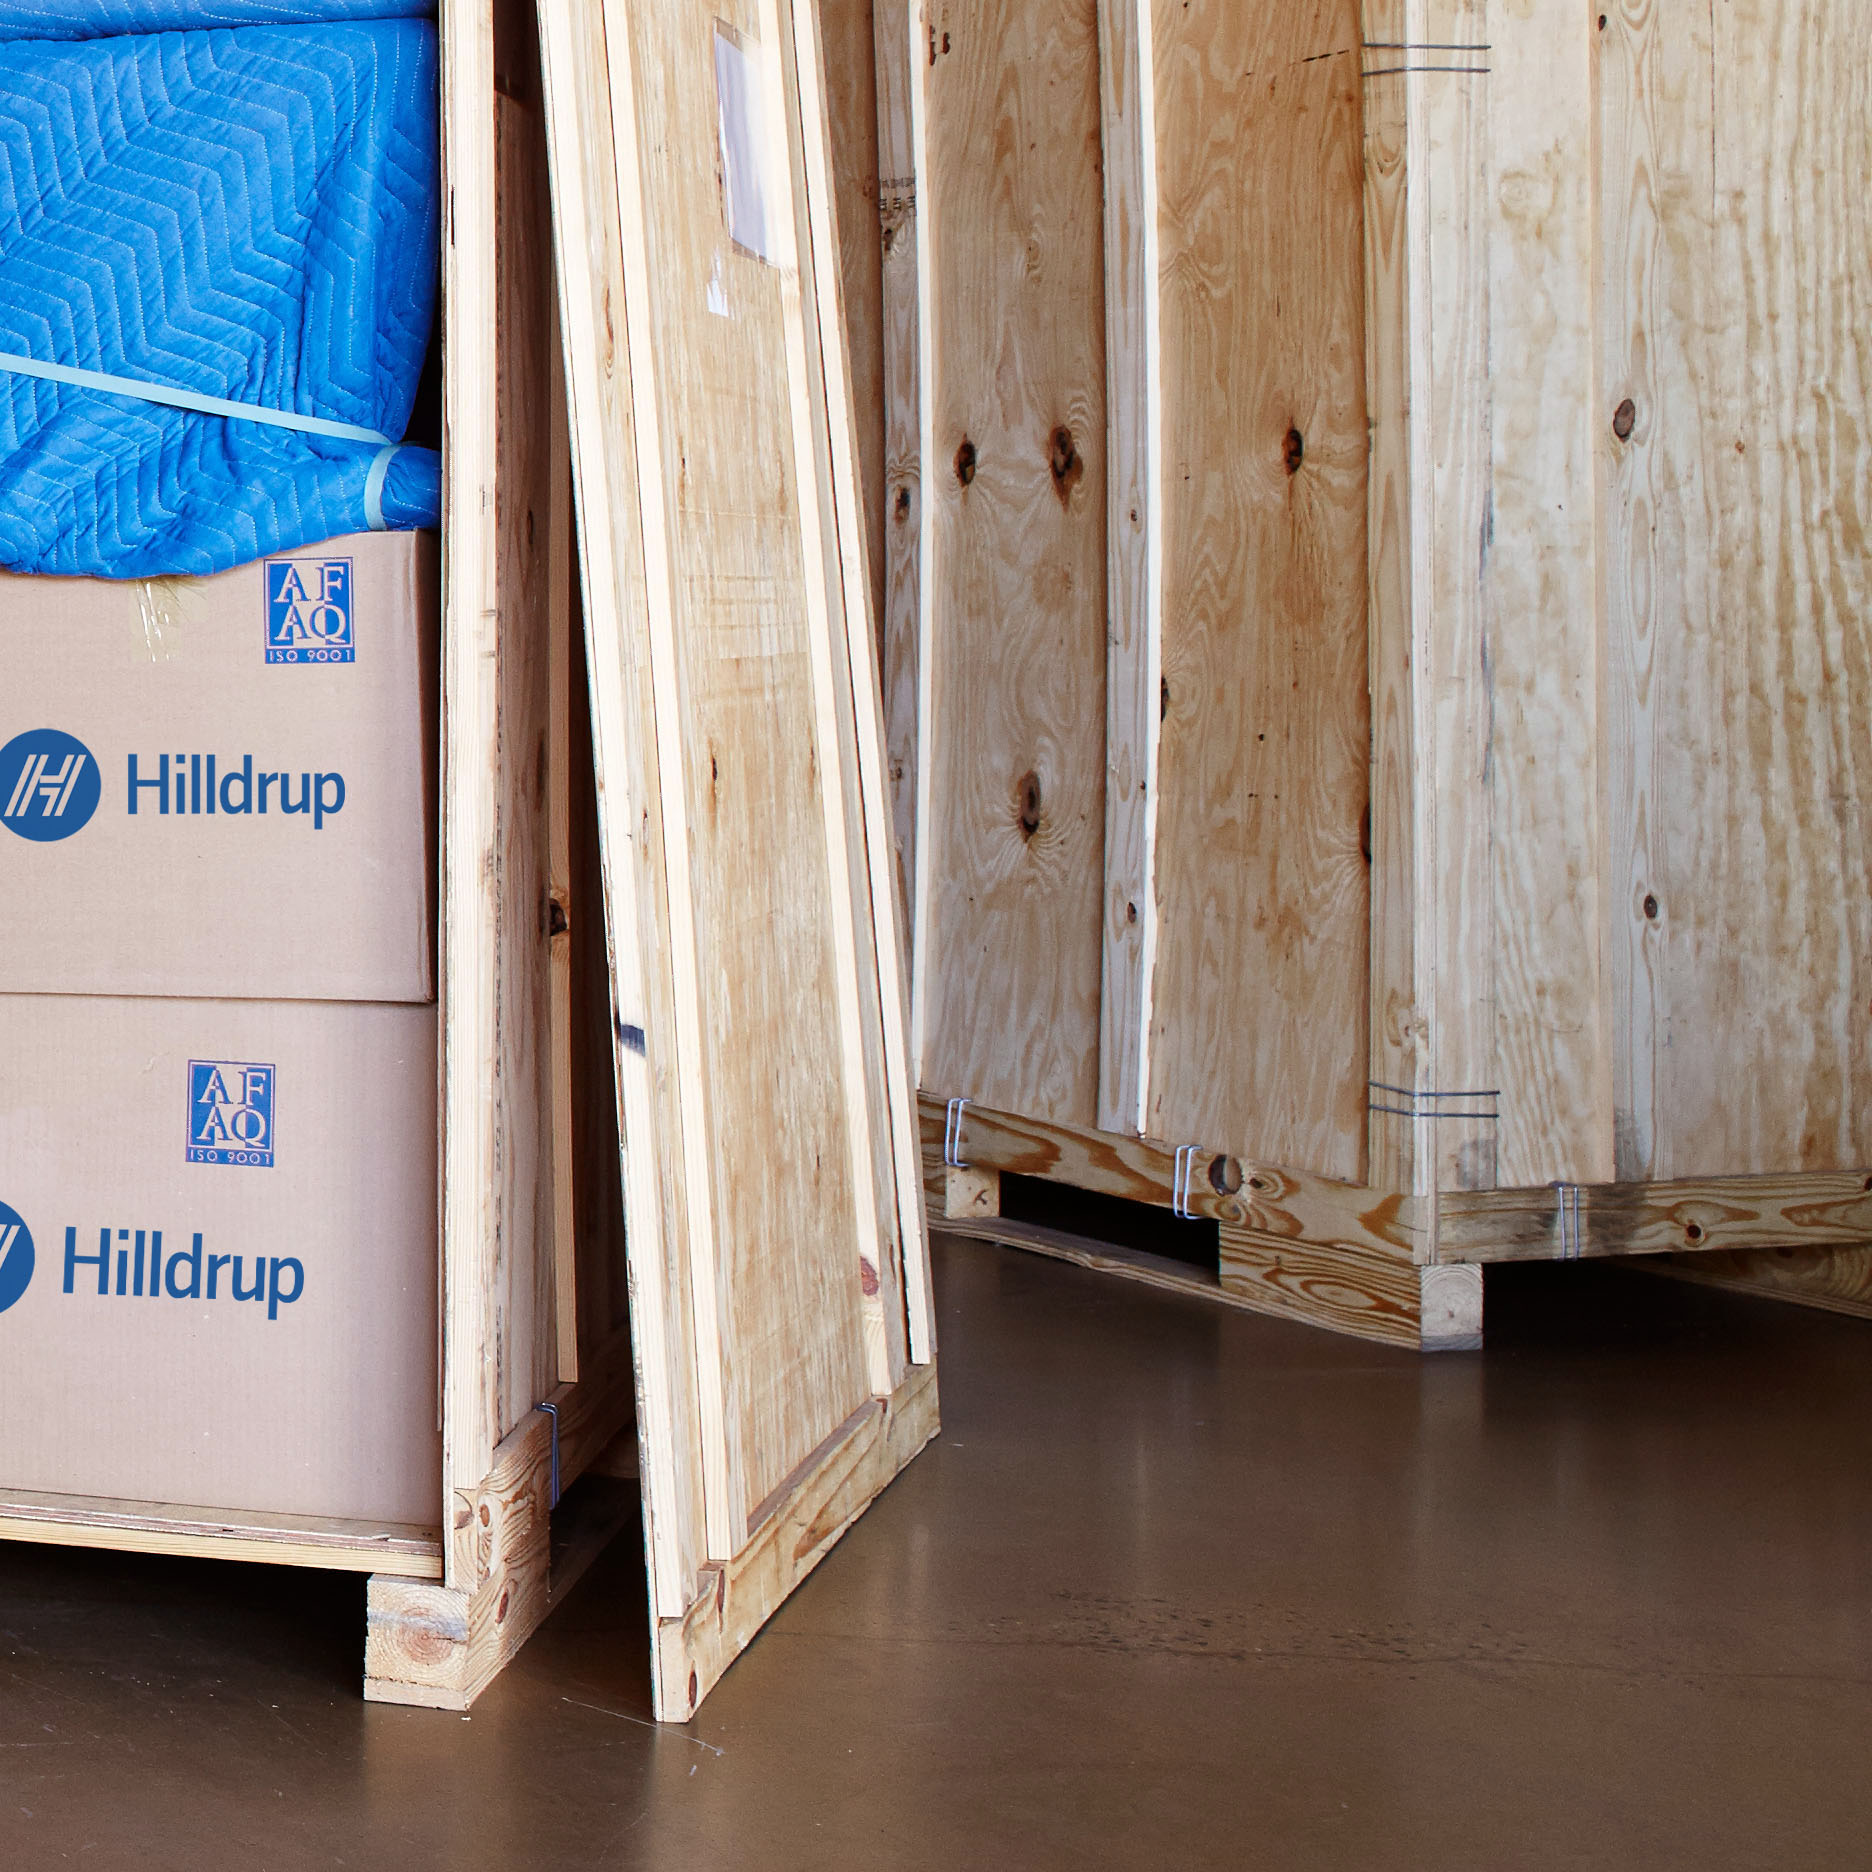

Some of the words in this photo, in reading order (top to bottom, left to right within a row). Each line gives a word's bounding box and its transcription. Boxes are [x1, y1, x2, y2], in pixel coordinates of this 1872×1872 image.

[269, 650, 298, 662] ISO
[307, 649, 351, 662] 9001
[127, 753, 346, 830] Hilldrup
[190, 1149, 218, 1161] ISO
[227, 1151, 270, 1164] 9001
[62, 1225, 305, 1320] Hilldrup
